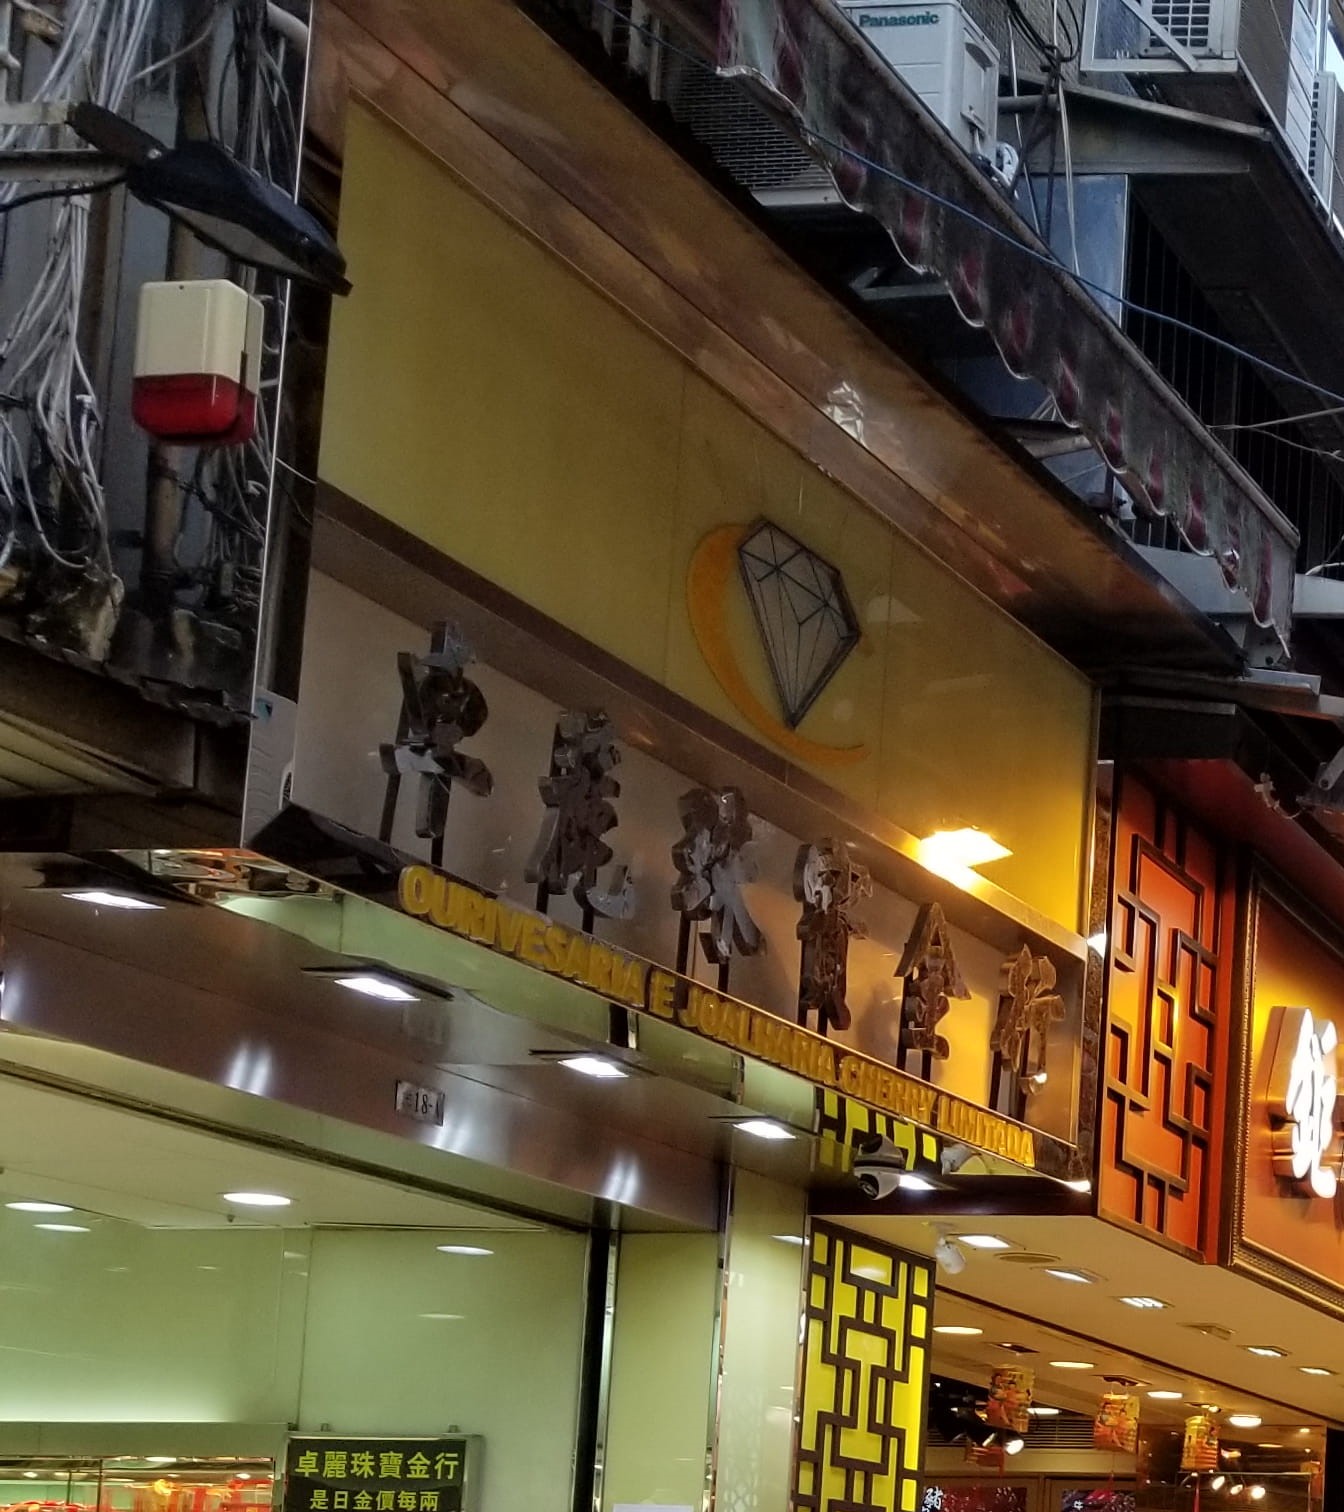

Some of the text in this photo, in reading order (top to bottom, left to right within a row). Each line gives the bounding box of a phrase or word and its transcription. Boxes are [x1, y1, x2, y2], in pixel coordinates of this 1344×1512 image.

[859, 11, 939, 27] Panasonic
[401, 865, 1034, 1167] OURIVESARIA E JOALHARIA CHERRY LIMITADA
[294, 1451, 459, 1479] 卓麗珠寶金行
[310, 1490, 440, 1511] 是日金價每兩
